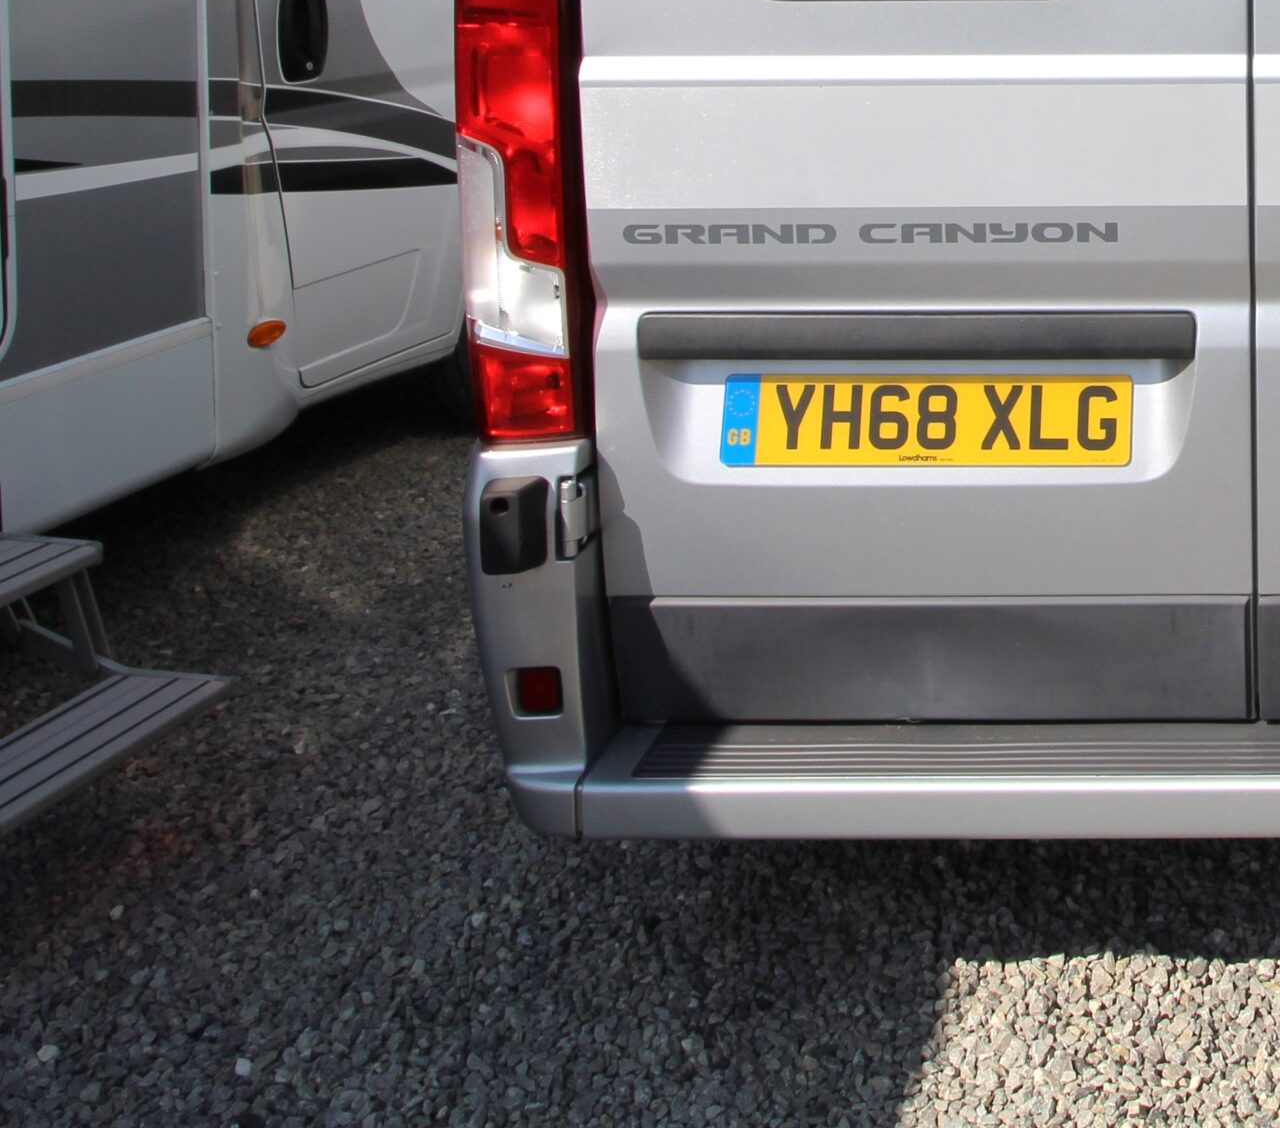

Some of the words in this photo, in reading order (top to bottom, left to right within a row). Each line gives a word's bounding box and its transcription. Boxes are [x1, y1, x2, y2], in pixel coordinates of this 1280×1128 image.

[621, 223, 838, 245] GRAND
[858, 222, 1119, 244] CANYON
[775, 384, 959, 451] YH68
[980, 384, 1118, 452] XLG
[727, 428, 752, 446] GB
[898, 454, 938, 462] Lowdhams
